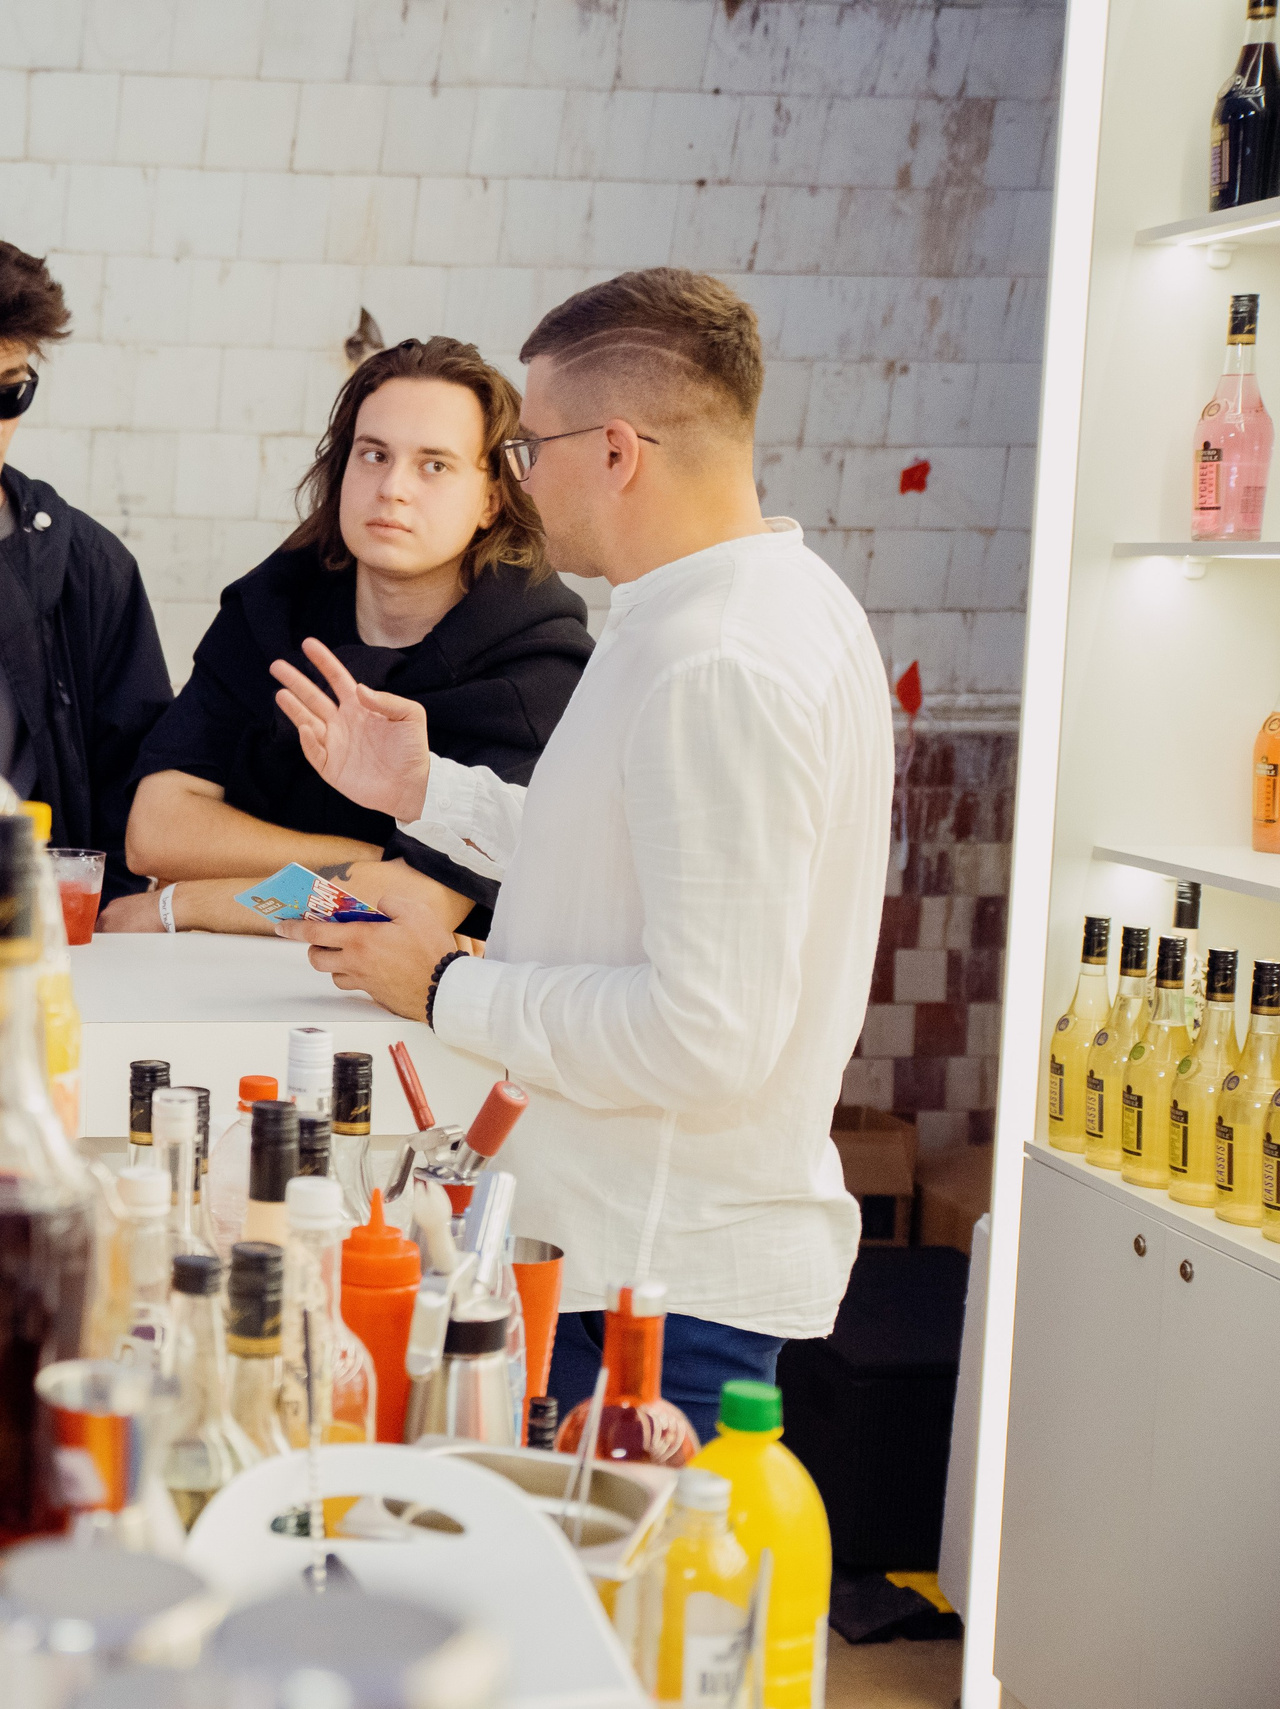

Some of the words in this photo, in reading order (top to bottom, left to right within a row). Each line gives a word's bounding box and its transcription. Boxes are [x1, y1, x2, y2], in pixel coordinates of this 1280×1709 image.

[1199, 464, 1208, 505] LYCHEE
[1086, 1095, 1097, 1131] CASSIS
[1216, 1144, 1226, 1183] CASSIS
[1264, 1163, 1275, 1202] CASSIS
